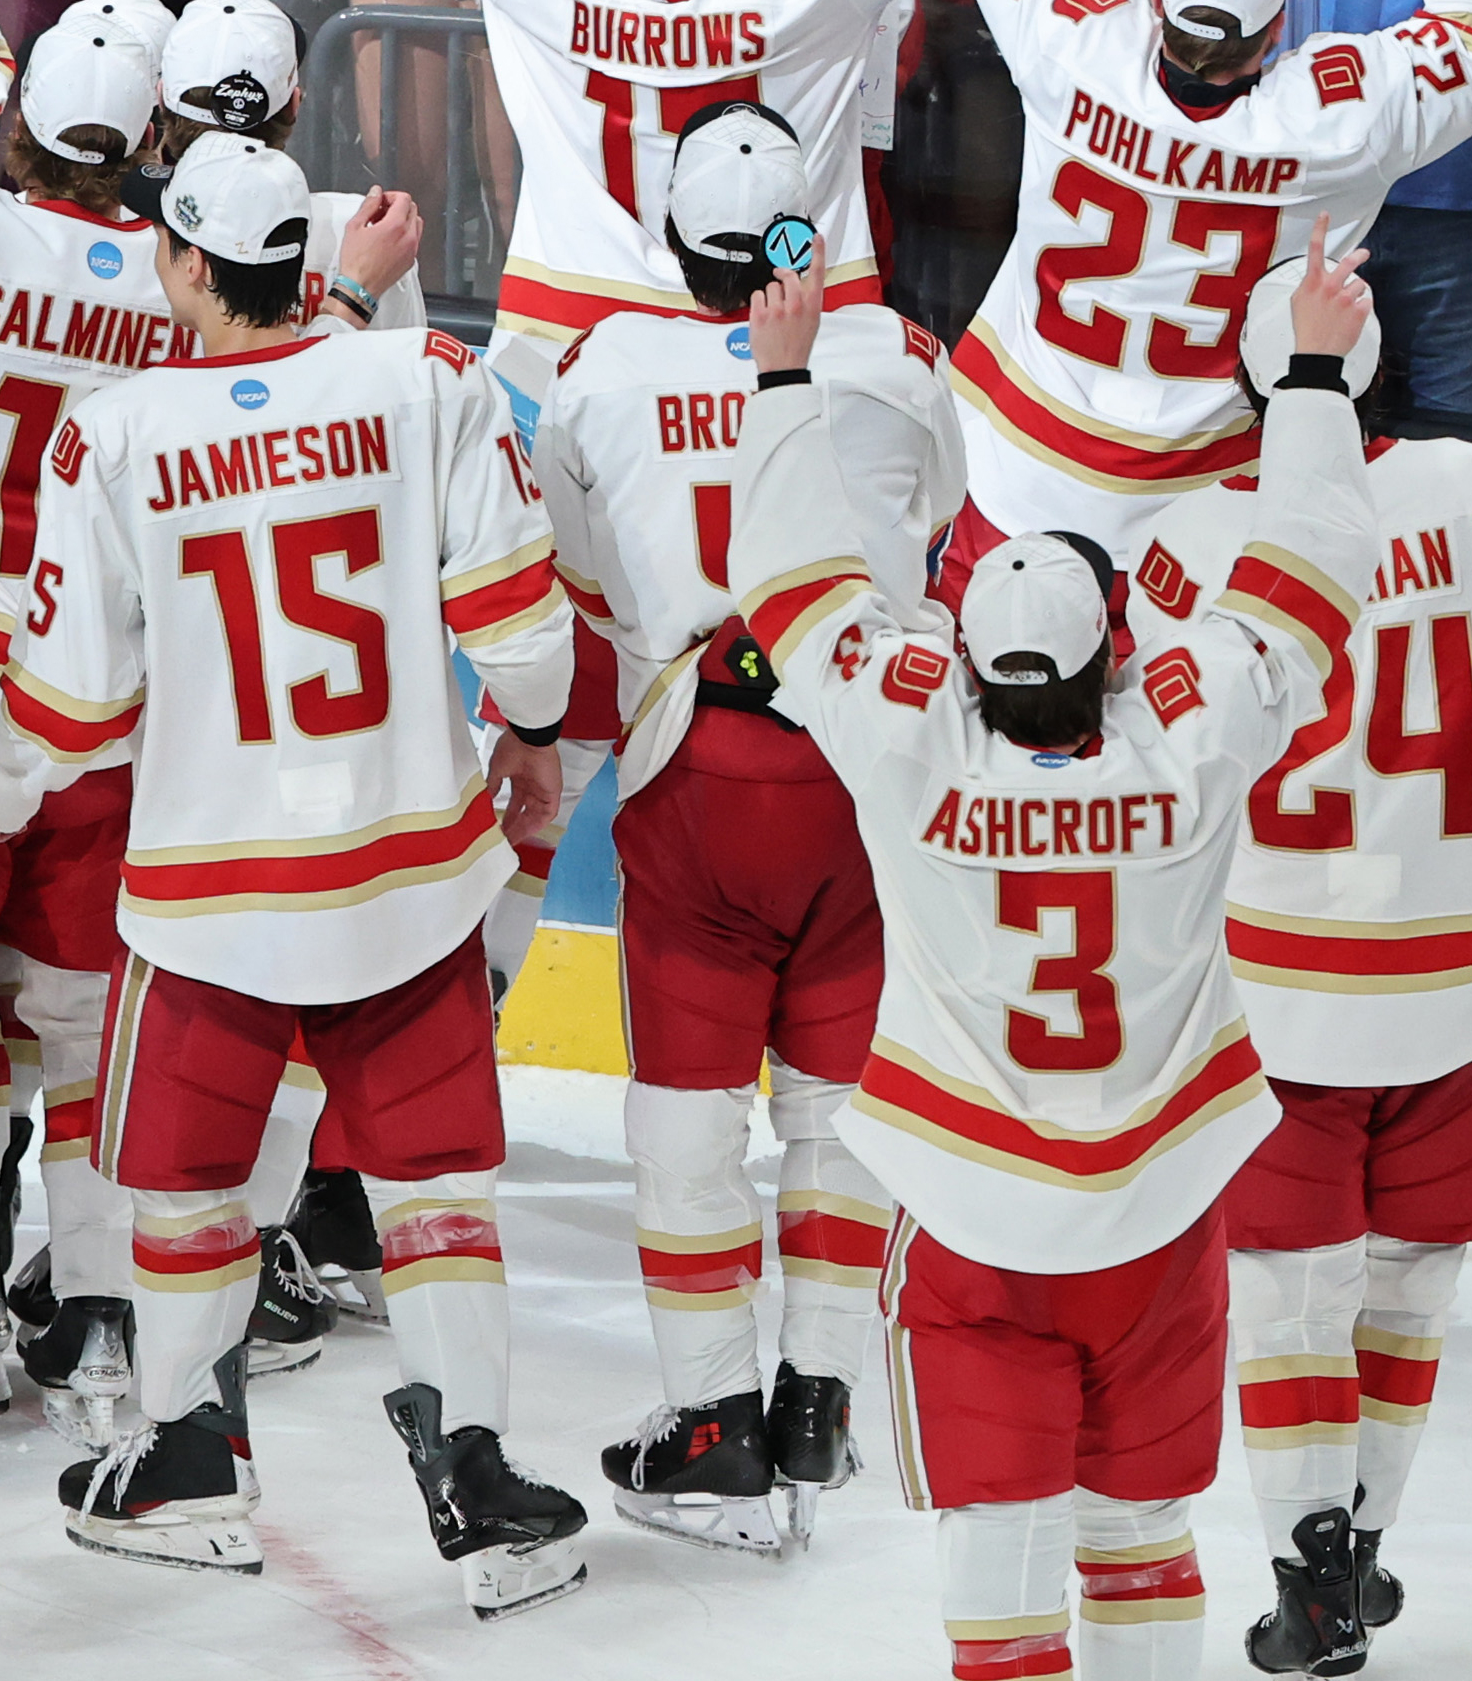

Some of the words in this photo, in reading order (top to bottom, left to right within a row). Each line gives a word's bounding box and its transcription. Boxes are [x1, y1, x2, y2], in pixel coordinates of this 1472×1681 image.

[570, 0, 767, 69] BURROWS
[214, 83, 265, 104] Zephyr
[1063, 89, 1302, 195] POHLKAMP
[1034, 155, 1285, 371] 23
[236, 391, 268, 403] NCAA
[657, 392, 746, 455] BRO
[147, 413, 391, 513] JAMIESON
[919, 786, 1181, 859] ASHCROFT
[993, 868, 1127, 1075] 3
[263, 1299, 300, 1325] BAUER
